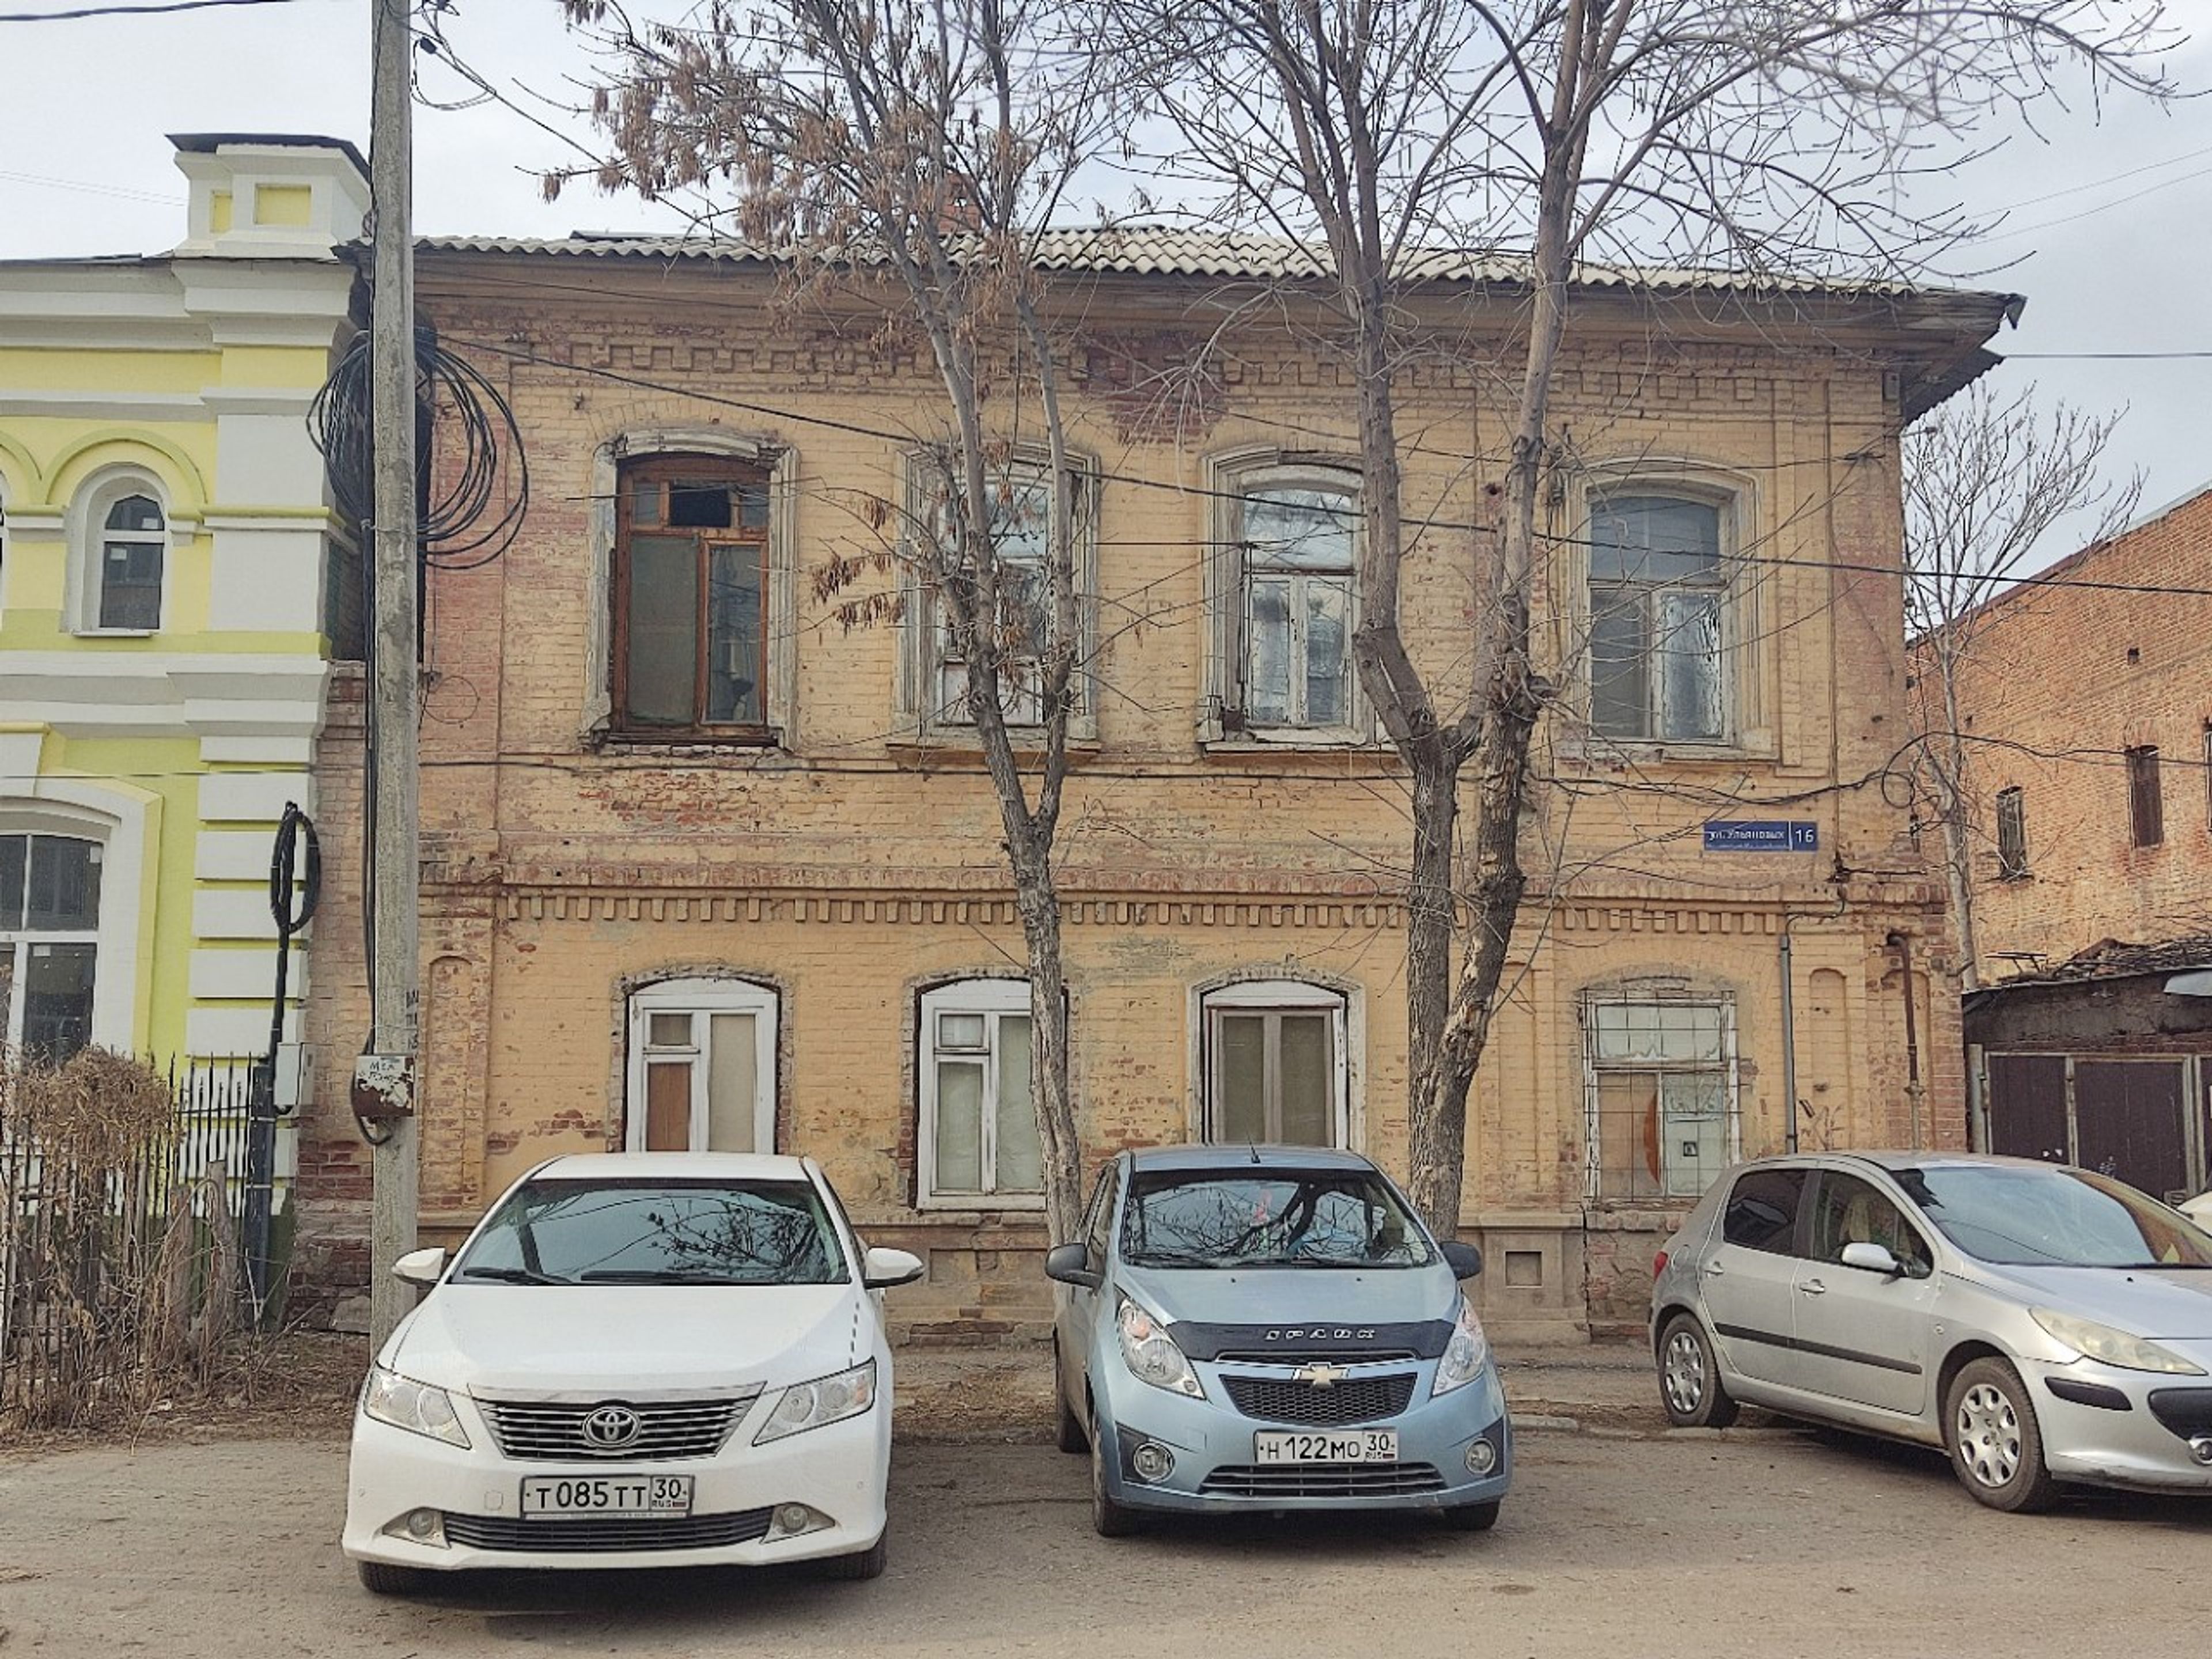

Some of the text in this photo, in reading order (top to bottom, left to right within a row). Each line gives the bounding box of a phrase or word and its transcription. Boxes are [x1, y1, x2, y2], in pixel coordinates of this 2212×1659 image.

[1796, 830, 1814, 843] 16
[1267, 1436, 1361, 1460] Н122МО
[1367, 1434, 1389, 1451] 30
[536, 1481, 647, 1509] Т085ТТ
[654, 1479, 681, 1499] 30
[652, 1499, 672, 1508] RUS
